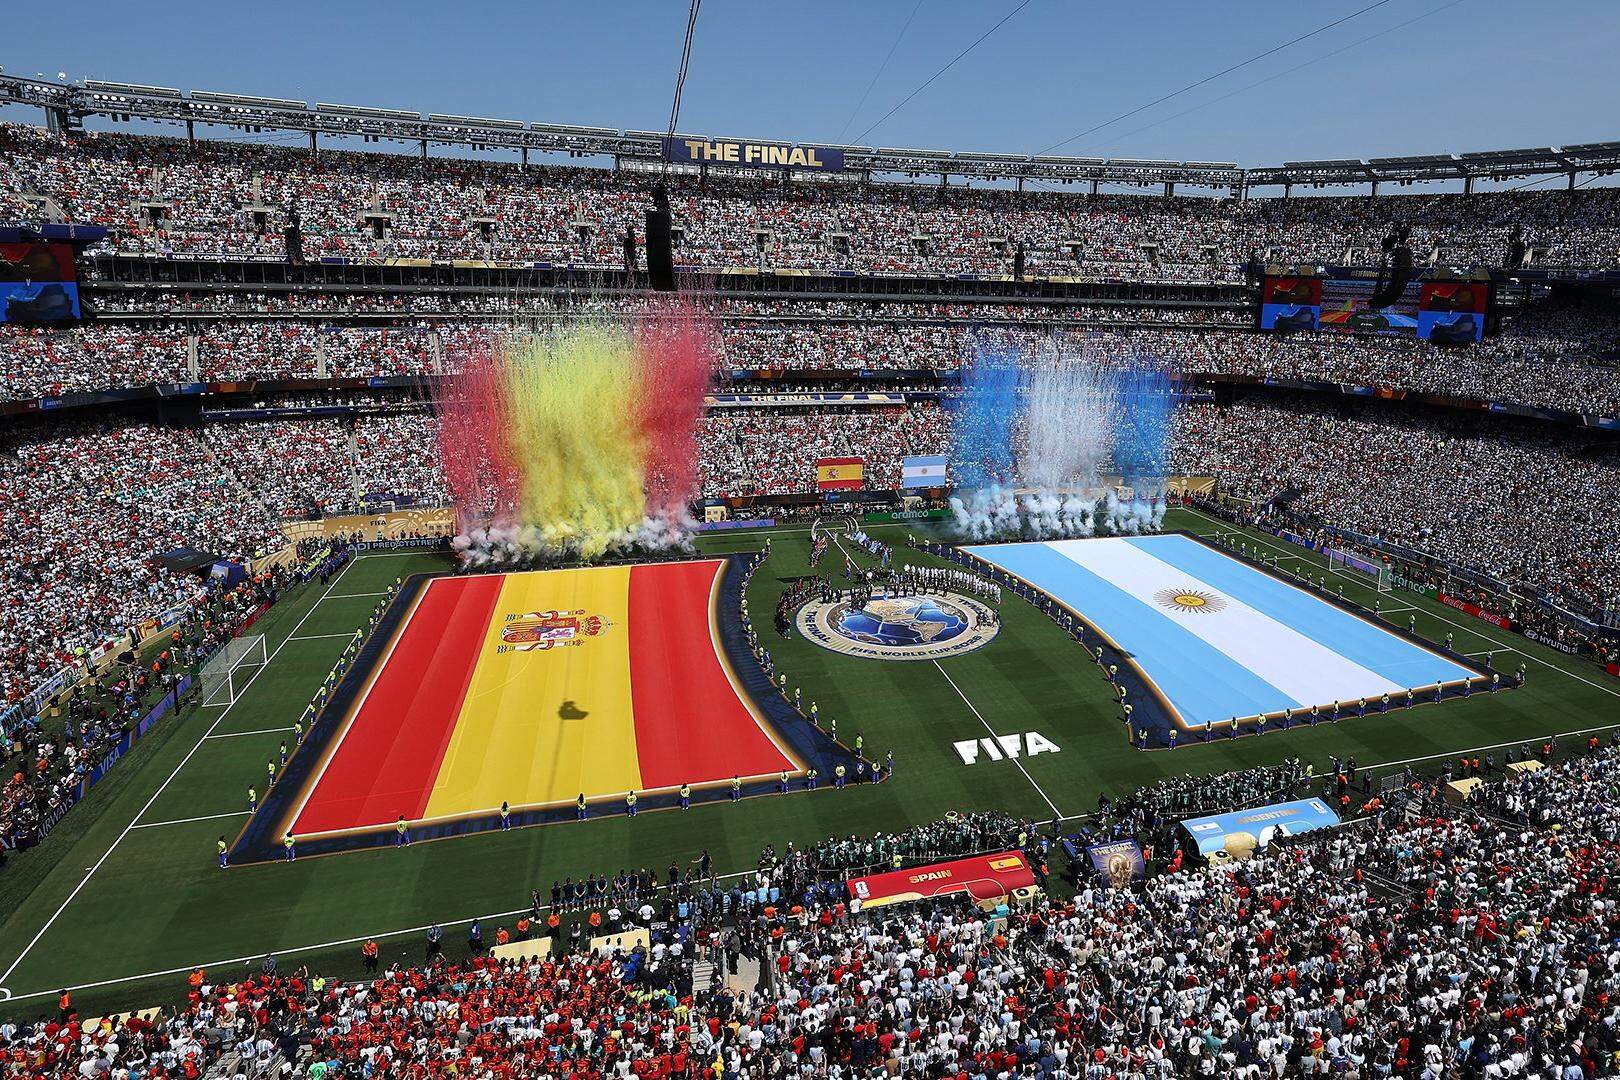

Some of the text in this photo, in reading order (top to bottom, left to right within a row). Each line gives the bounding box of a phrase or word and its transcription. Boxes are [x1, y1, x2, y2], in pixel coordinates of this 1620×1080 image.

[685, 140, 823, 167] THE FINAL
[749, 394, 814, 402] THE FINAL
[891, 509, 929, 520] aramco
[1291, 535, 1306, 548] VISA
[1387, 572, 1426, 595] aramco
[805, 611, 831, 643] THE FINAL
[850, 646, 878, 655] FIFA
[928, 647, 951, 655] CUP
[951, 635, 983, 650] 2026
[953, 731, 1061, 765] FIFA
[100, 747, 121, 775] VISA
[1092, 842, 1135, 856] THE FINAL
[908, 869, 953, 884] SPAIN
